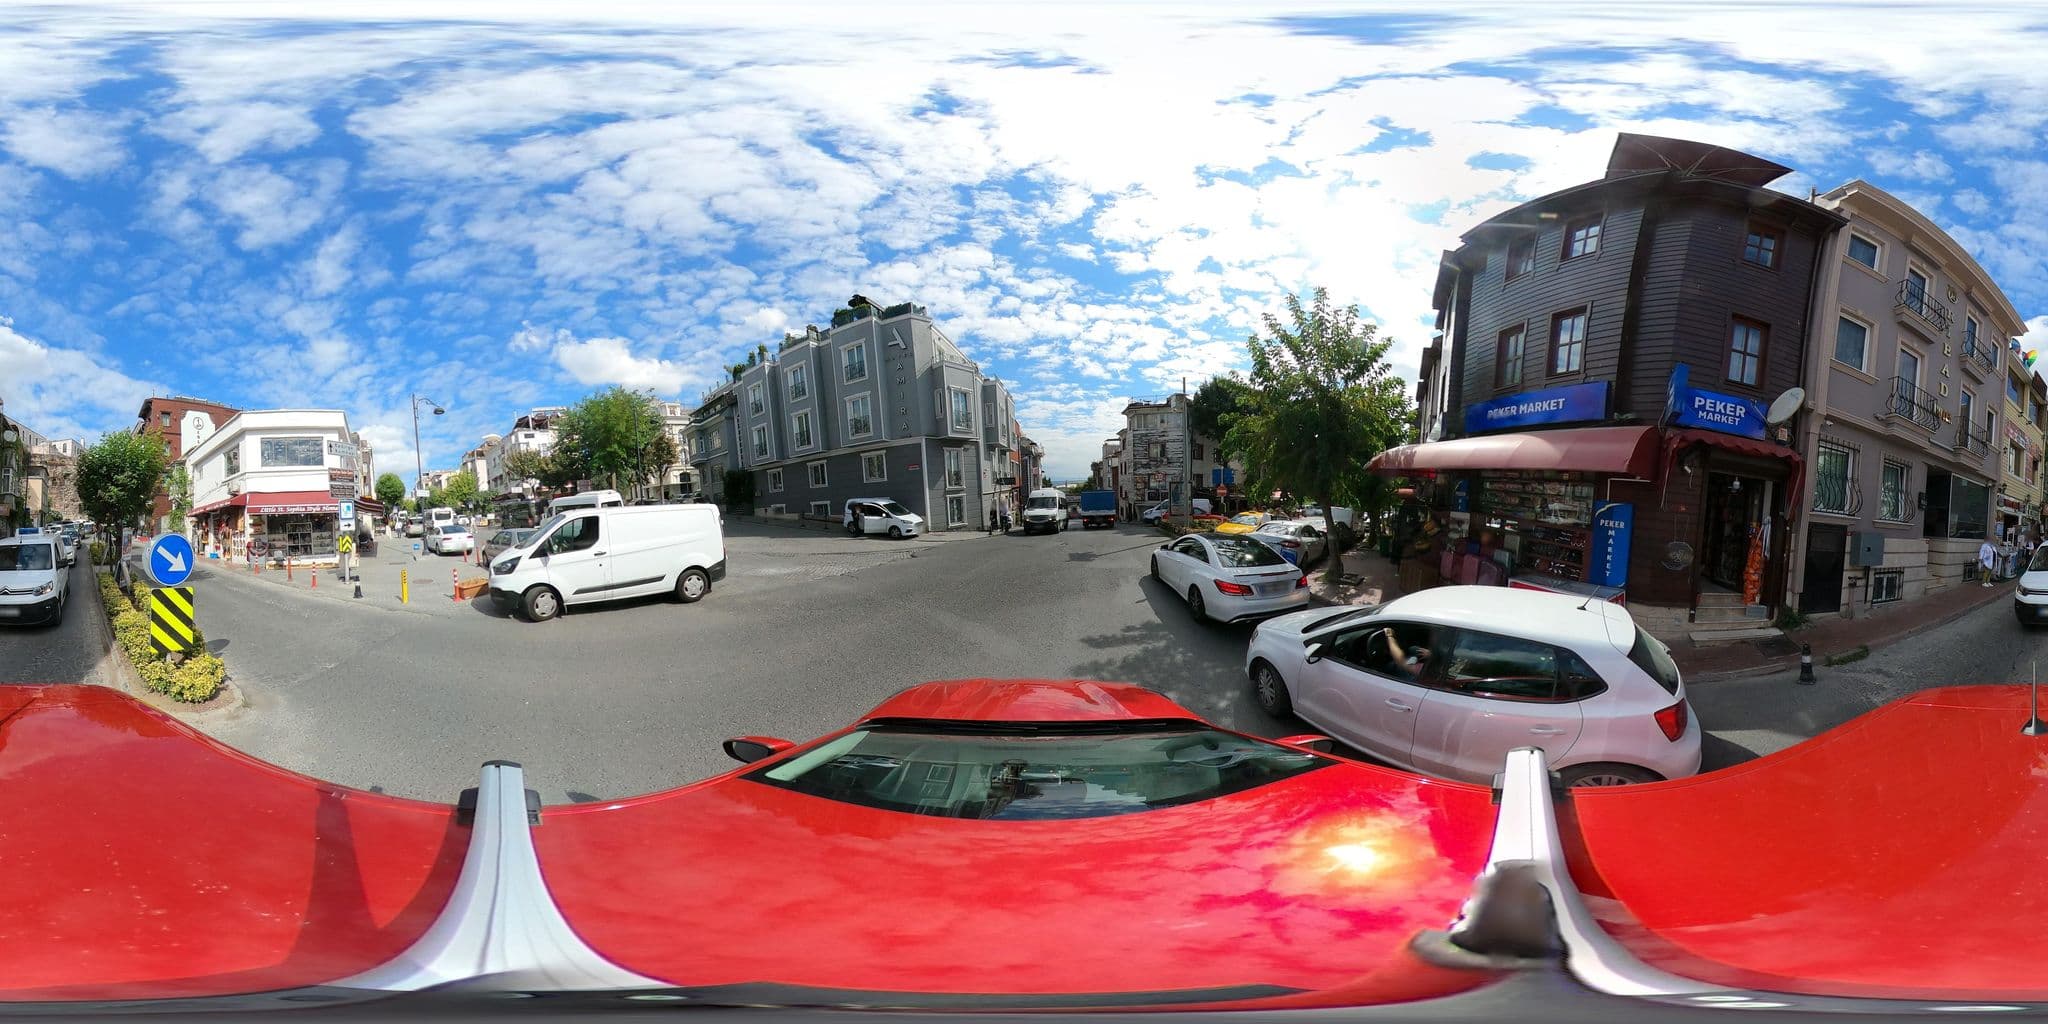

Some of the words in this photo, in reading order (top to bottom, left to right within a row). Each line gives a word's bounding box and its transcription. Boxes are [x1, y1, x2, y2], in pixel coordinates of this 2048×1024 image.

[896, 361, 909, 432] AMIRA
[1694, 396, 1746, 417] PEKER
[1487, 405, 1517, 419] PEKER
[1519, 398, 1565, 414] MARKET
[1698, 410, 1741, 425] MARKET
[1600, 519, 1625, 528] PEKER
[1606, 530, 1615, 576] MARKET
